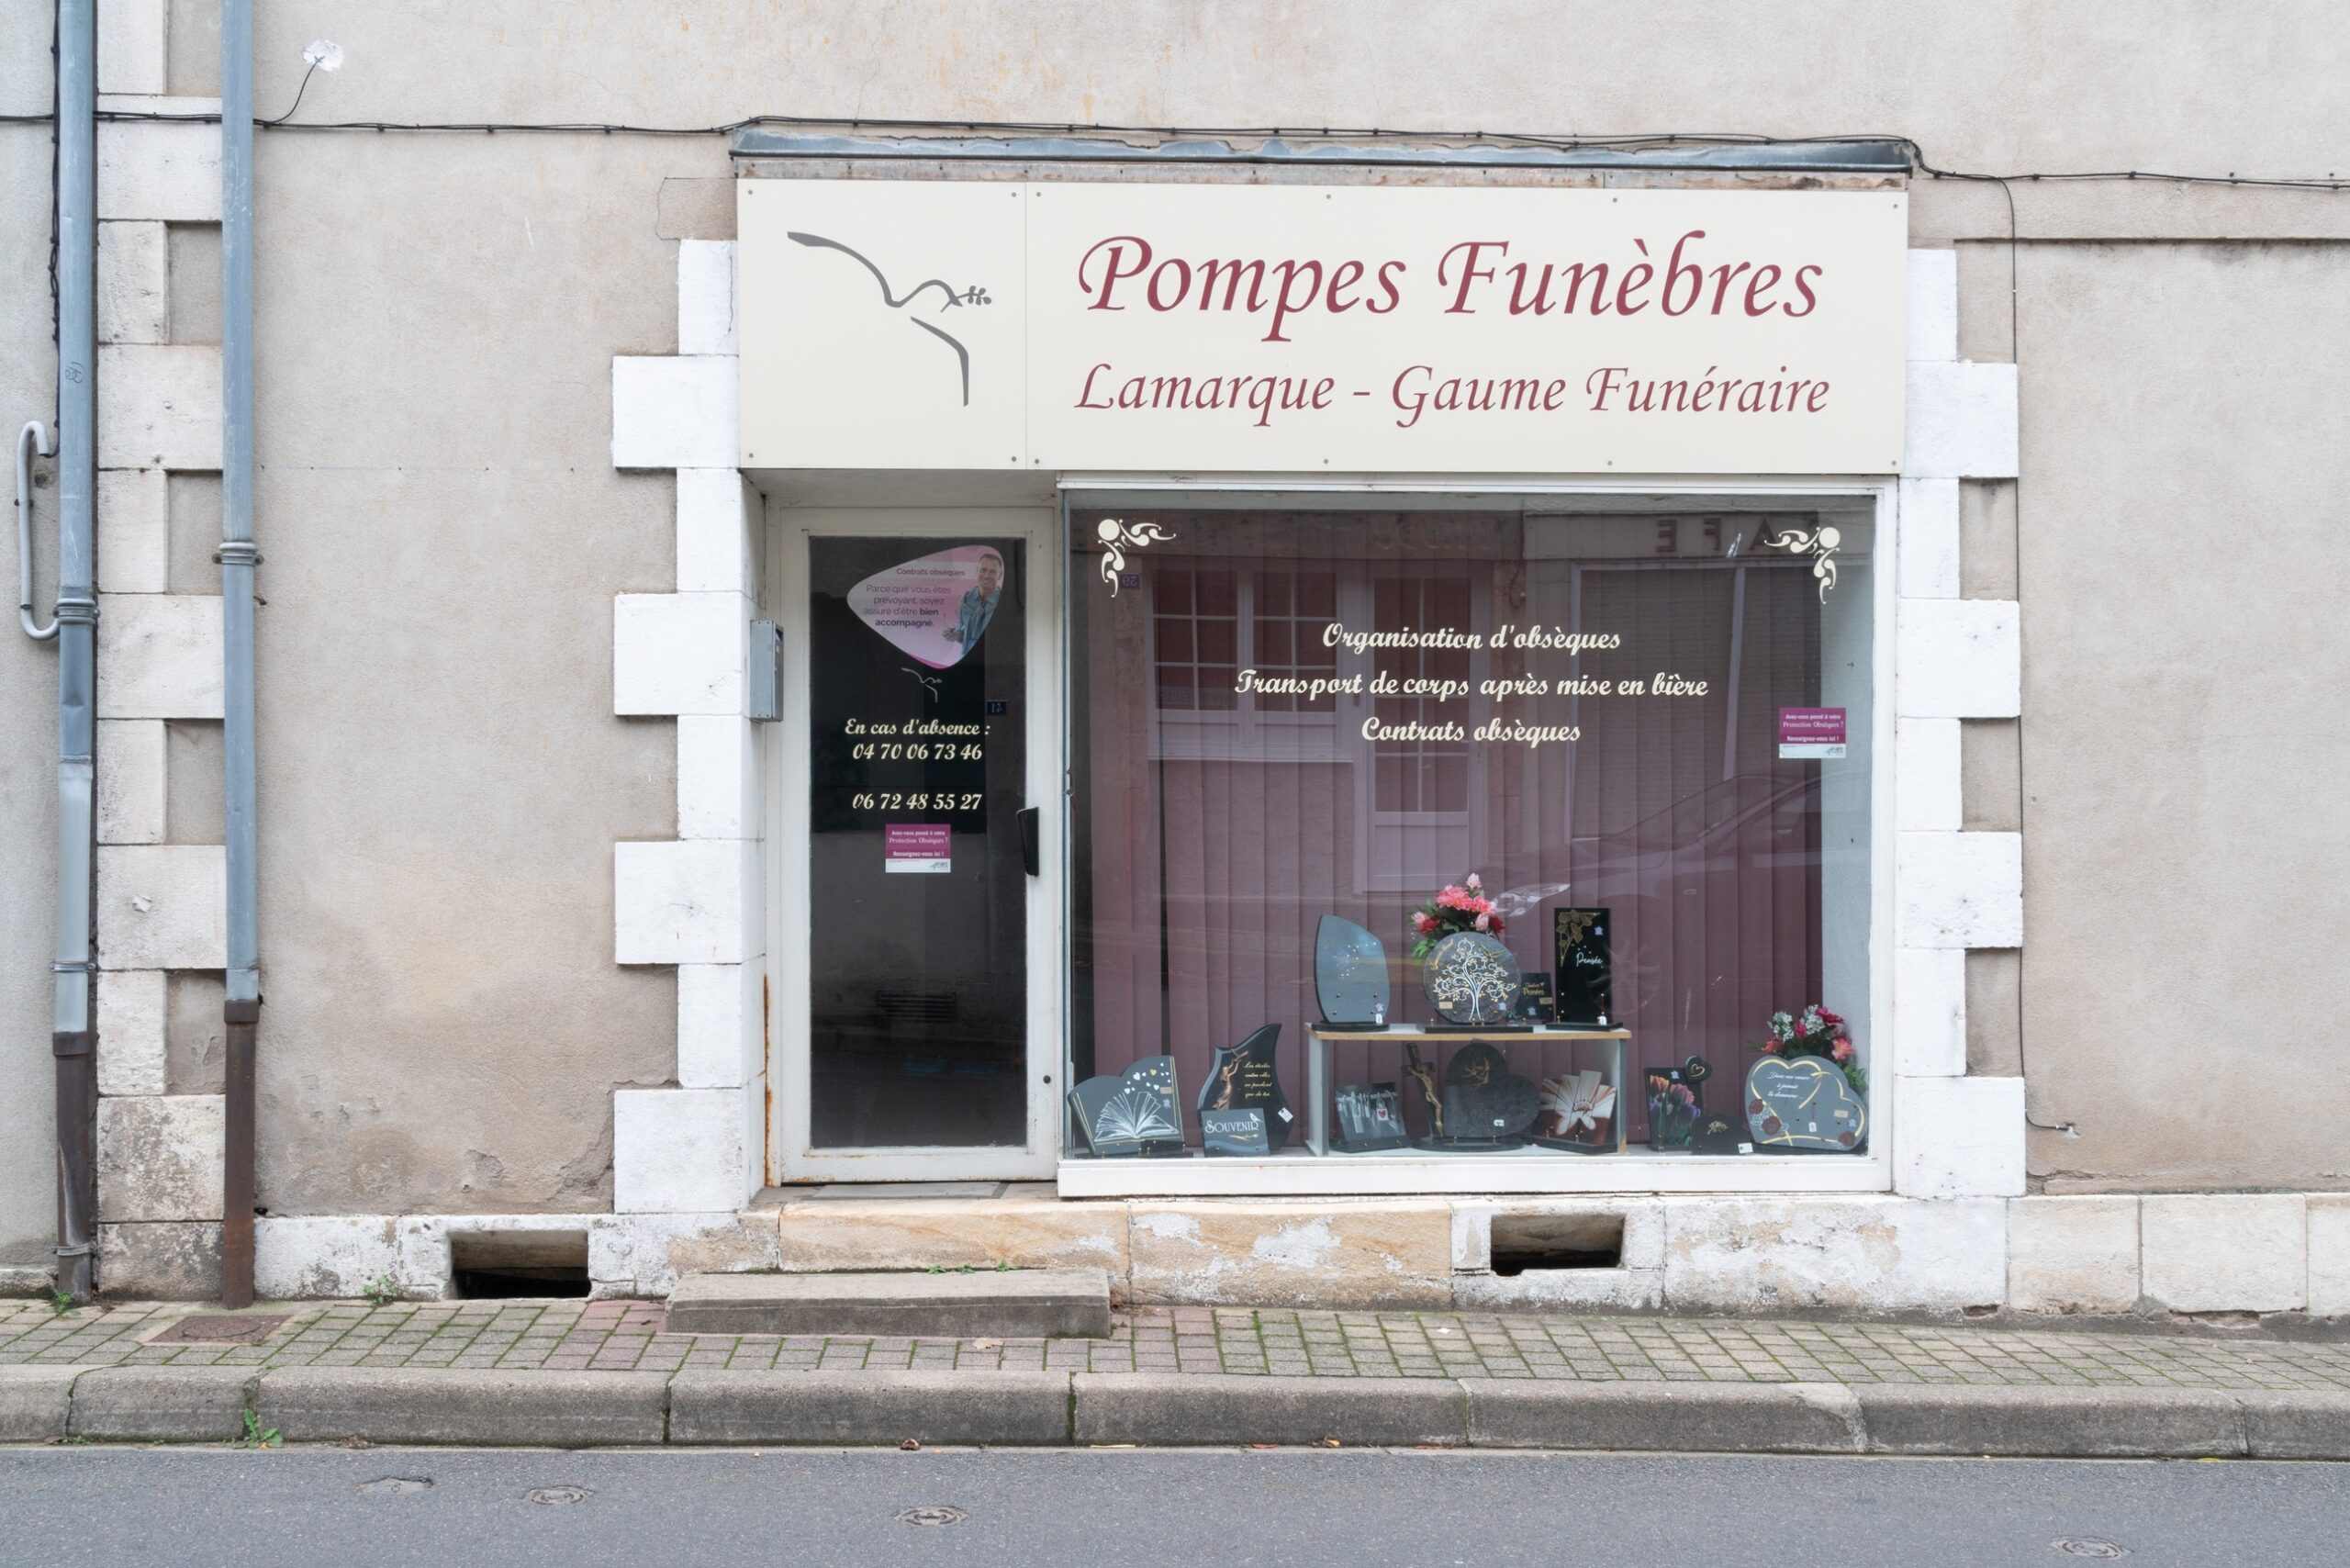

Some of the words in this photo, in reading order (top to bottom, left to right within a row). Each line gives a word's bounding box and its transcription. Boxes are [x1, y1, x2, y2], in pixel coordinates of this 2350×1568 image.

[1079, 236, 1406, 342] Pompes
[1438, 230, 1822, 317] Funèbres
[1074, 364, 1334, 427] Lamarque
[1393, 365, 1565, 428] Gaume
[1586, 364, 1830, 413] Funéraire
[867, 585, 890, 593] Parce
[892, 587, 908, 595] que
[919, 607, 939, 615] bien
[1323, 622, 1483, 654] Organisation
[1490, 624, 1621, 656] d'obsèques
[1235, 668, 1364, 701] Transport
[1369, 670, 1399, 695] de
[1403, 678, 1470, 702] corps
[1479, 672, 1549, 702] après
[1556, 674, 1612, 696] mise
[1617, 680, 1646, 696] en
[1651, 671, 1709, 696] bière
[845, 718, 867, 734] En
[870, 723, 897, 735] cas
[902, 719, 980, 735] d'absence
[1360, 716, 1465, 742] Contrats
[1472, 717, 1581, 749] obsèques
[852, 743, 875, 760] 04
[880, 743, 902, 760] 70
[906, 744, 929, 760] 06
[934, 744, 957, 760] 73
[960, 744, 982, 760] 46
[852, 793, 875, 810] 06
[880, 793, 902, 810] 72
[906, 793, 929, 810] 48
[933, 793, 956, 810] 55
[959, 793, 982, 810] 27
